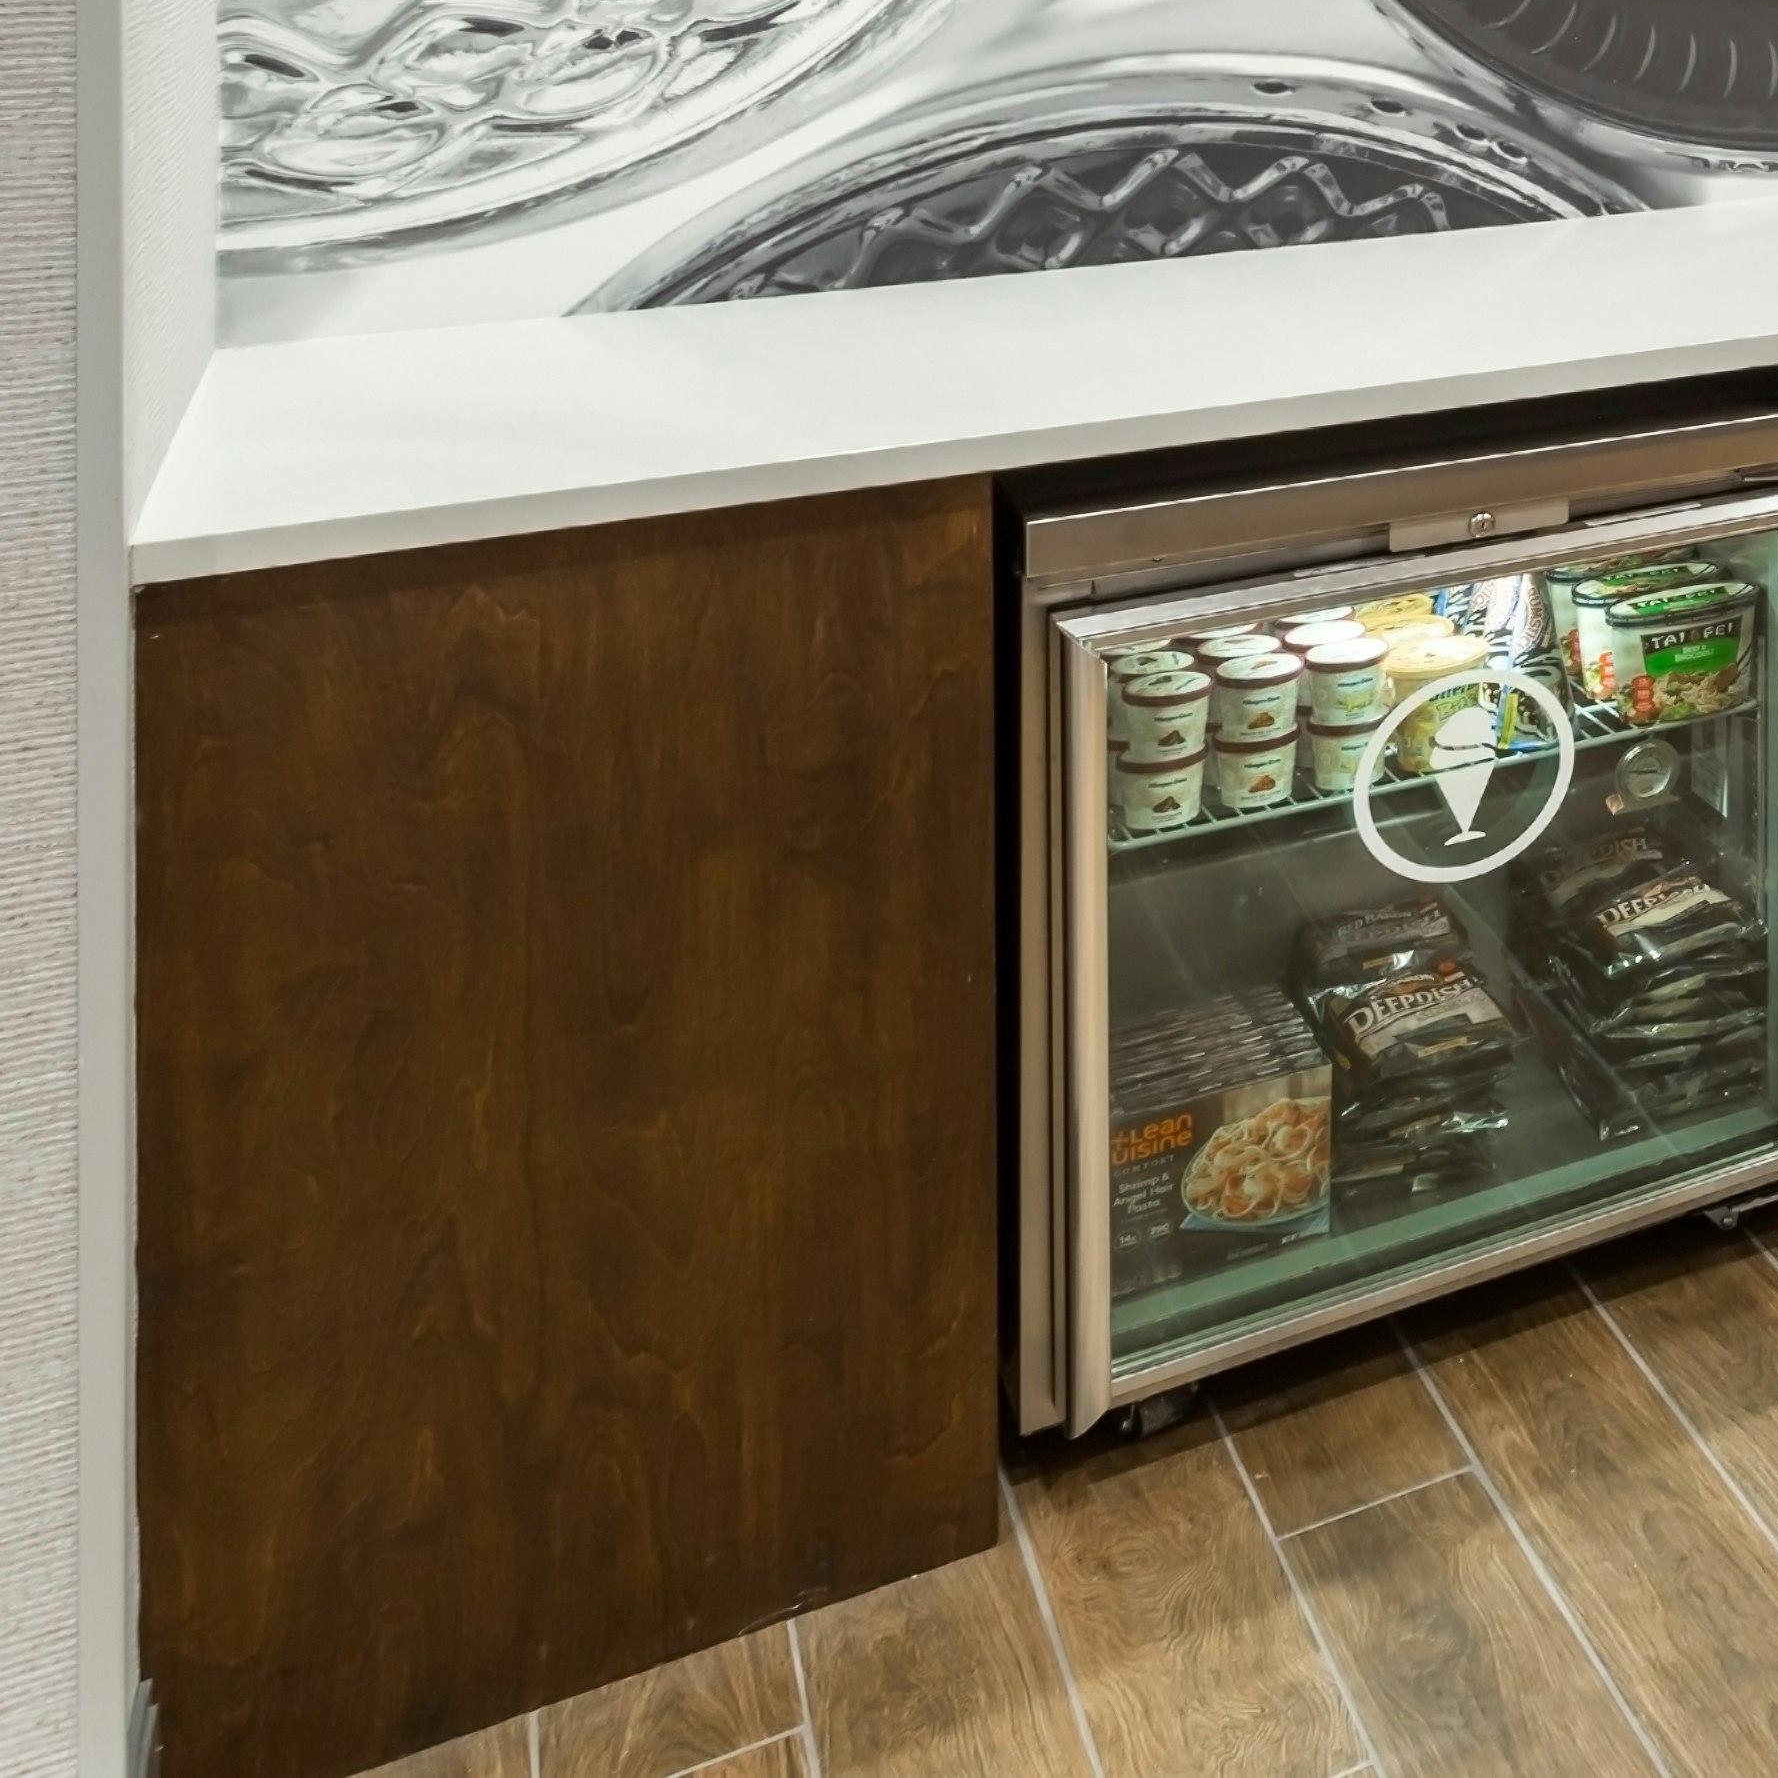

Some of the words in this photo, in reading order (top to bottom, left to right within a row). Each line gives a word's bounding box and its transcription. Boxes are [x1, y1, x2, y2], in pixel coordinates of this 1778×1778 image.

[1651, 632, 1685, 649] TAI
[1703, 622, 1733, 639] PEI
[1344, 977, 1473, 1036] DEEPDISH
[1130, 1114, 1193, 1146] Lean
[1113, 1190, 1147, 1207] Angel
[1149, 1182, 1174, 1196] Hair
[1118, 1175, 1160, 1194] Shrimp
[1127, 1198, 1161, 1215] Pasta
